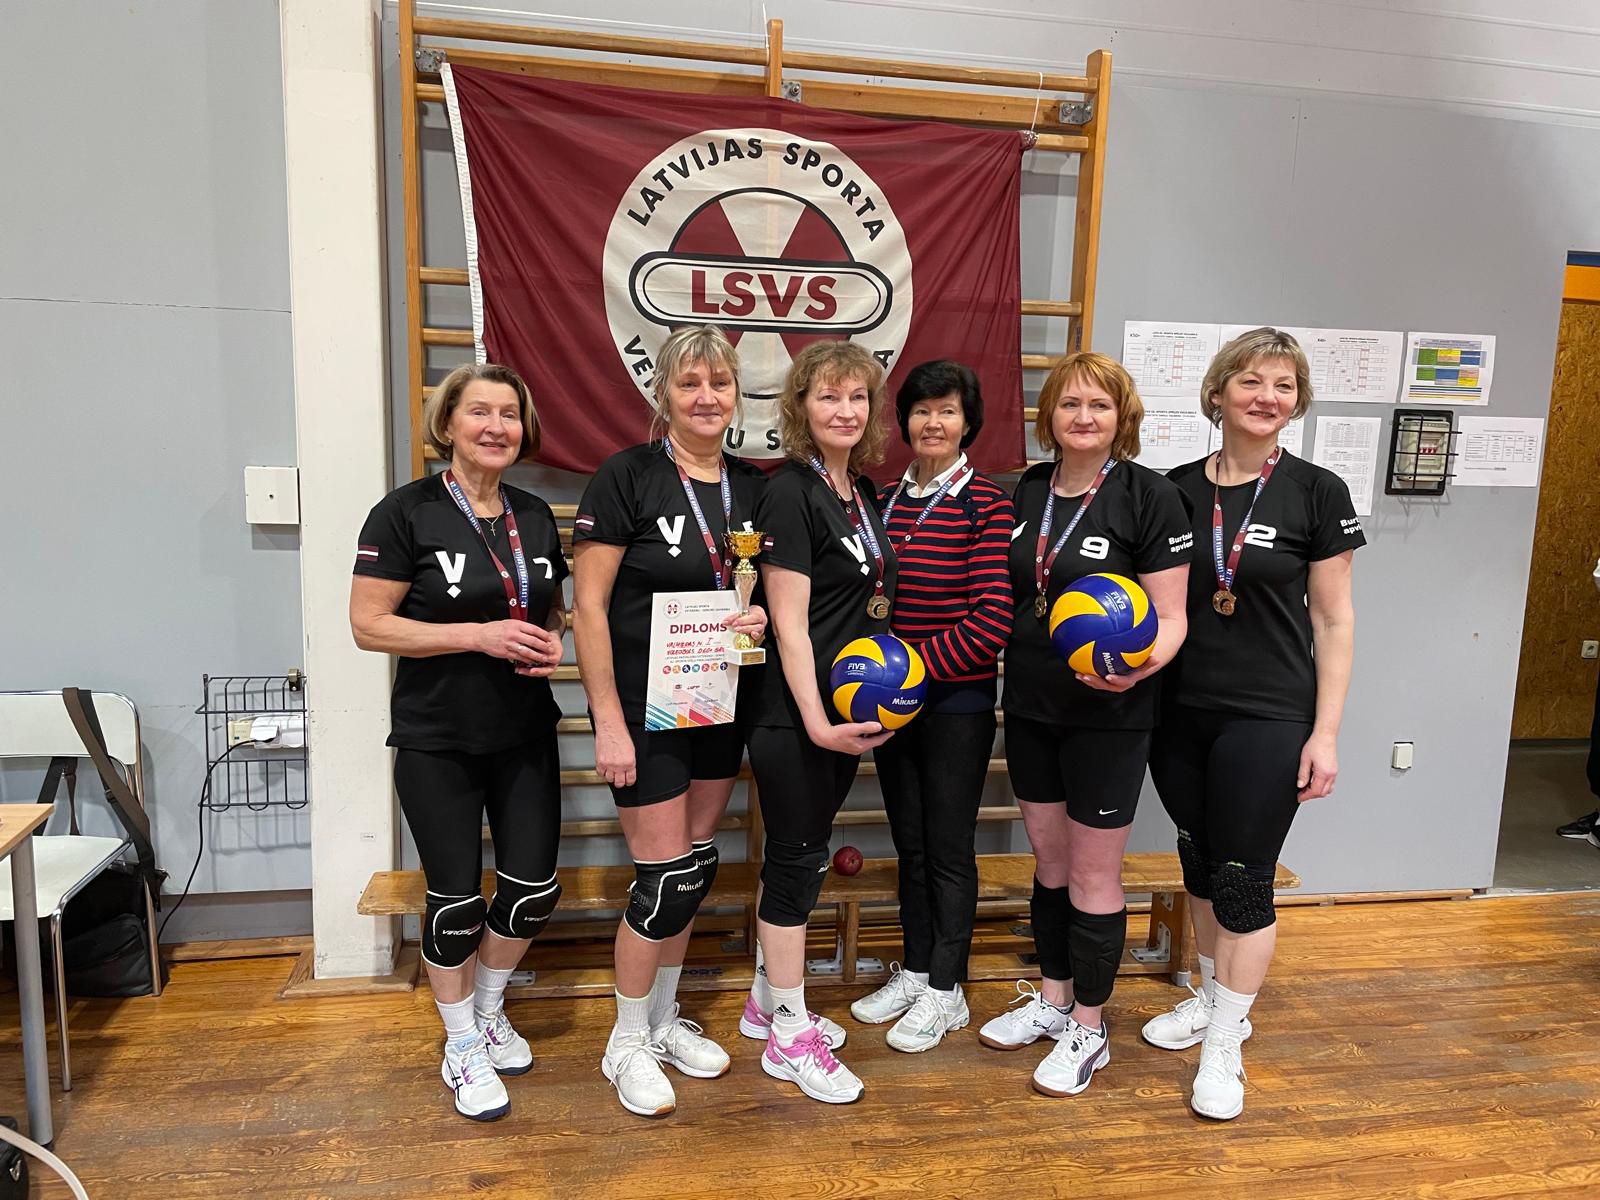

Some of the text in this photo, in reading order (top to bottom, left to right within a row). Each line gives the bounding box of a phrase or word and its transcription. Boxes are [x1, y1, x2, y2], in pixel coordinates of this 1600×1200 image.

[627, 138, 885, 242] LATVIJAS SPORTA
[691, 270, 837, 320] LSVS
[1079, 536, 1110, 560] 9
[1243, 523, 1277, 549] 2
[670, 622, 728, 634] DIPLOMS
